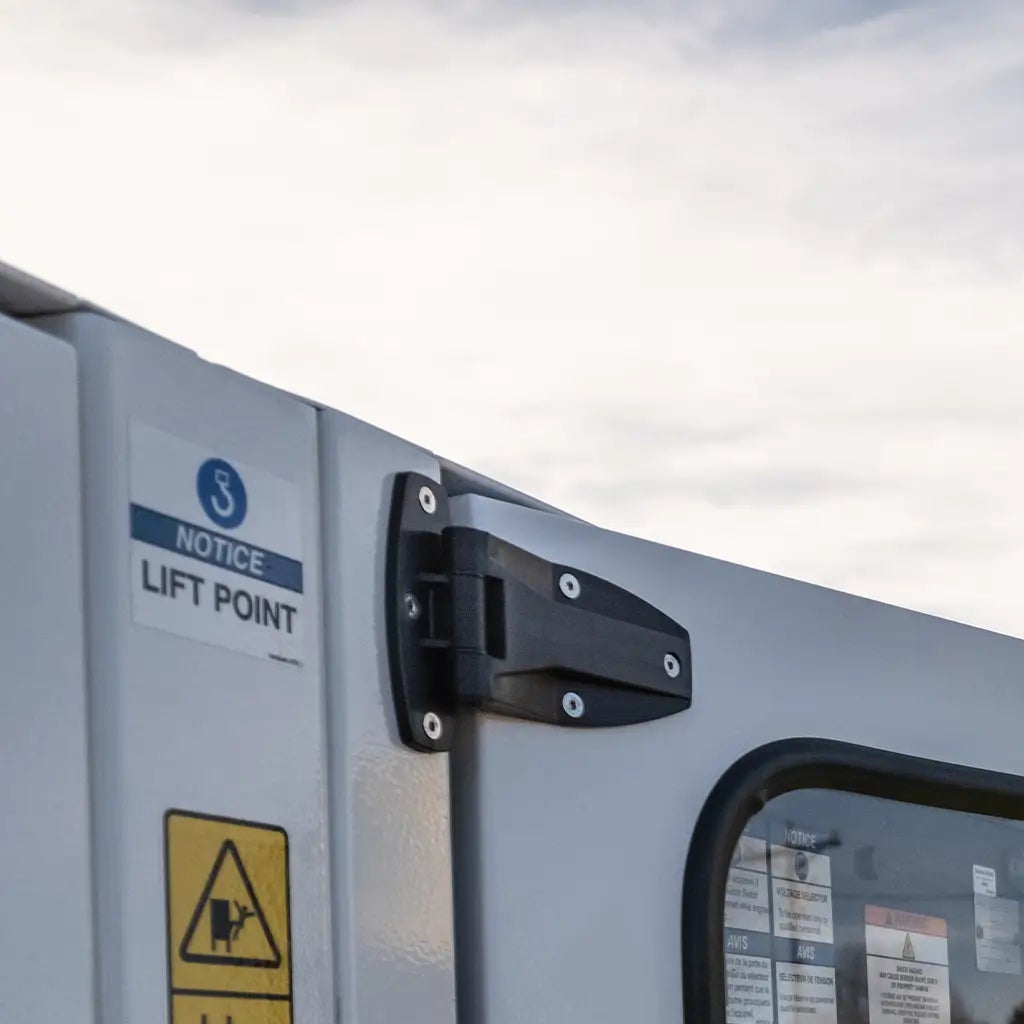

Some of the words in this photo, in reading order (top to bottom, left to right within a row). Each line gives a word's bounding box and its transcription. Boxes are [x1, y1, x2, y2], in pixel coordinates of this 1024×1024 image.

[176, 525, 264, 576] NOTICE
[142, 559, 205, 607] LIFT
[214, 582, 297, 634] POINT
[784, 828, 816, 848] NOTICE
[728, 934, 748, 950] AVIS
[796, 944, 816, 960] AVIS
